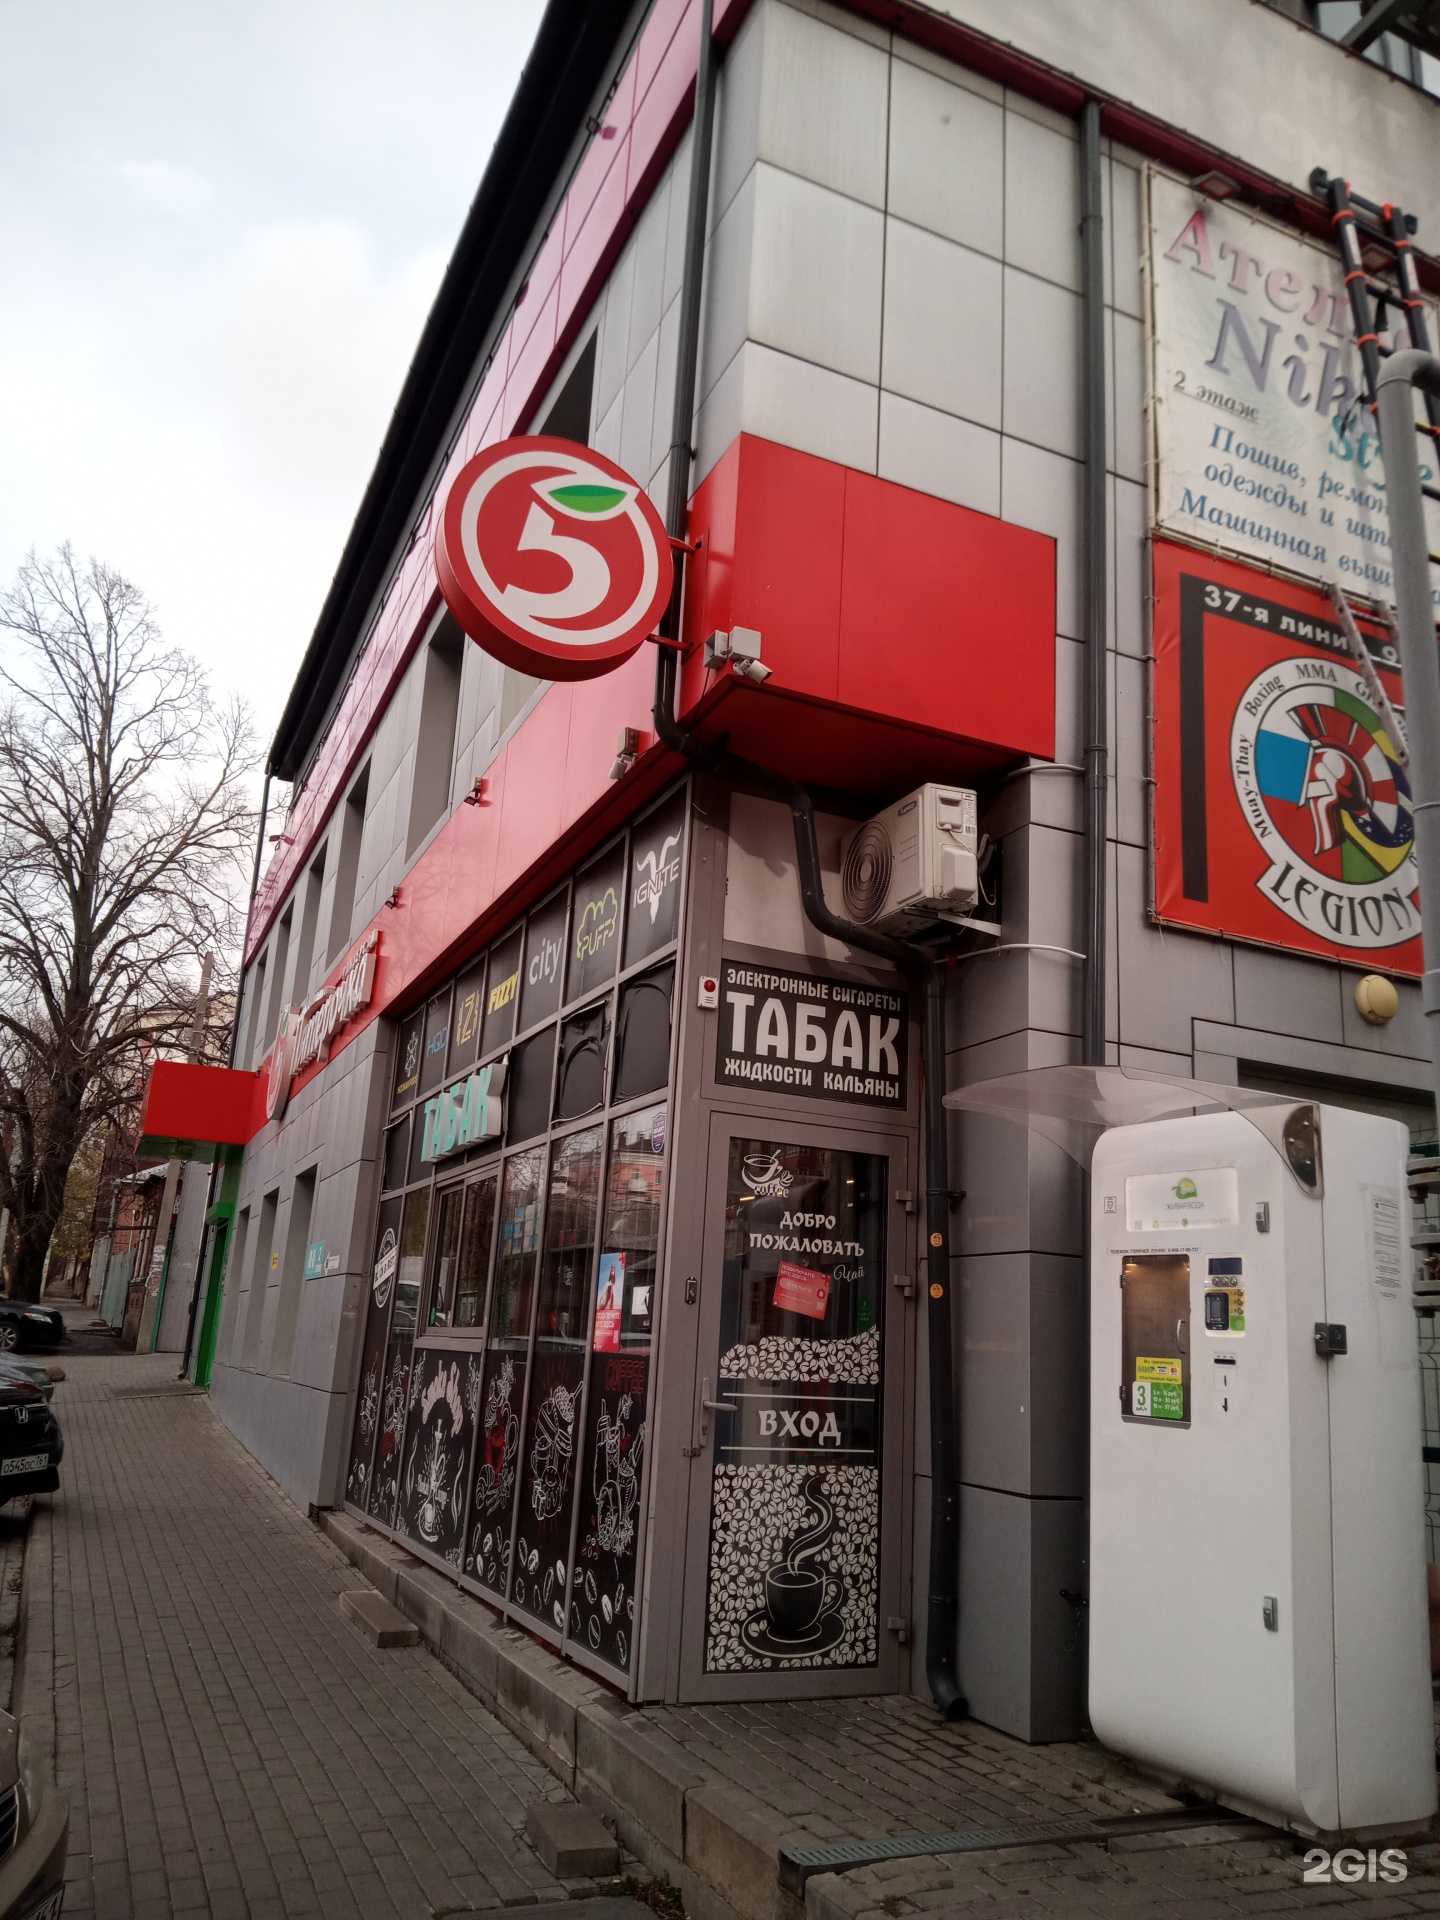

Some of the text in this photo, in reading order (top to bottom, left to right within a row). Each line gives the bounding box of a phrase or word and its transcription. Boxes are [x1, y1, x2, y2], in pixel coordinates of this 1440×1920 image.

[1174, 370, 1260, 419] 2 этаж
[1209, 423, 1390, 516] Пошив, ремон
[1204, 463, 1307, 516] одежды
[1320, 508, 1335, 527] и
[1179, 487, 1327, 563] Машинная
[1204, 584, 1269, 624] 37-я
[1279, 615, 1349, 651] лини
[1244, 674, 1286, 718] Boxing
[1295, 663, 1338, 683] MMA
[633, 857, 681, 908] IGNITE
[1269, 861, 1413, 937] LEGION
[528, 937, 563, 986] city
[726, 967, 901, 1012] ЭЛЕКТРОННЫЕ СИГАРЕТЫ
[726, 990, 900, 1076] ТАБАК
[724, 1057, 900, 1099] ЖИДКОСТИ КАЛЬЯНЫ
[749, 1232, 865, 1258] ПОЖАЛОВАТЬ
[779, 1211, 837, 1231] ДОБРО
[1137, 1385, 1146, 1406] 3
[758, 1409, 842, 1447] ВХОД
